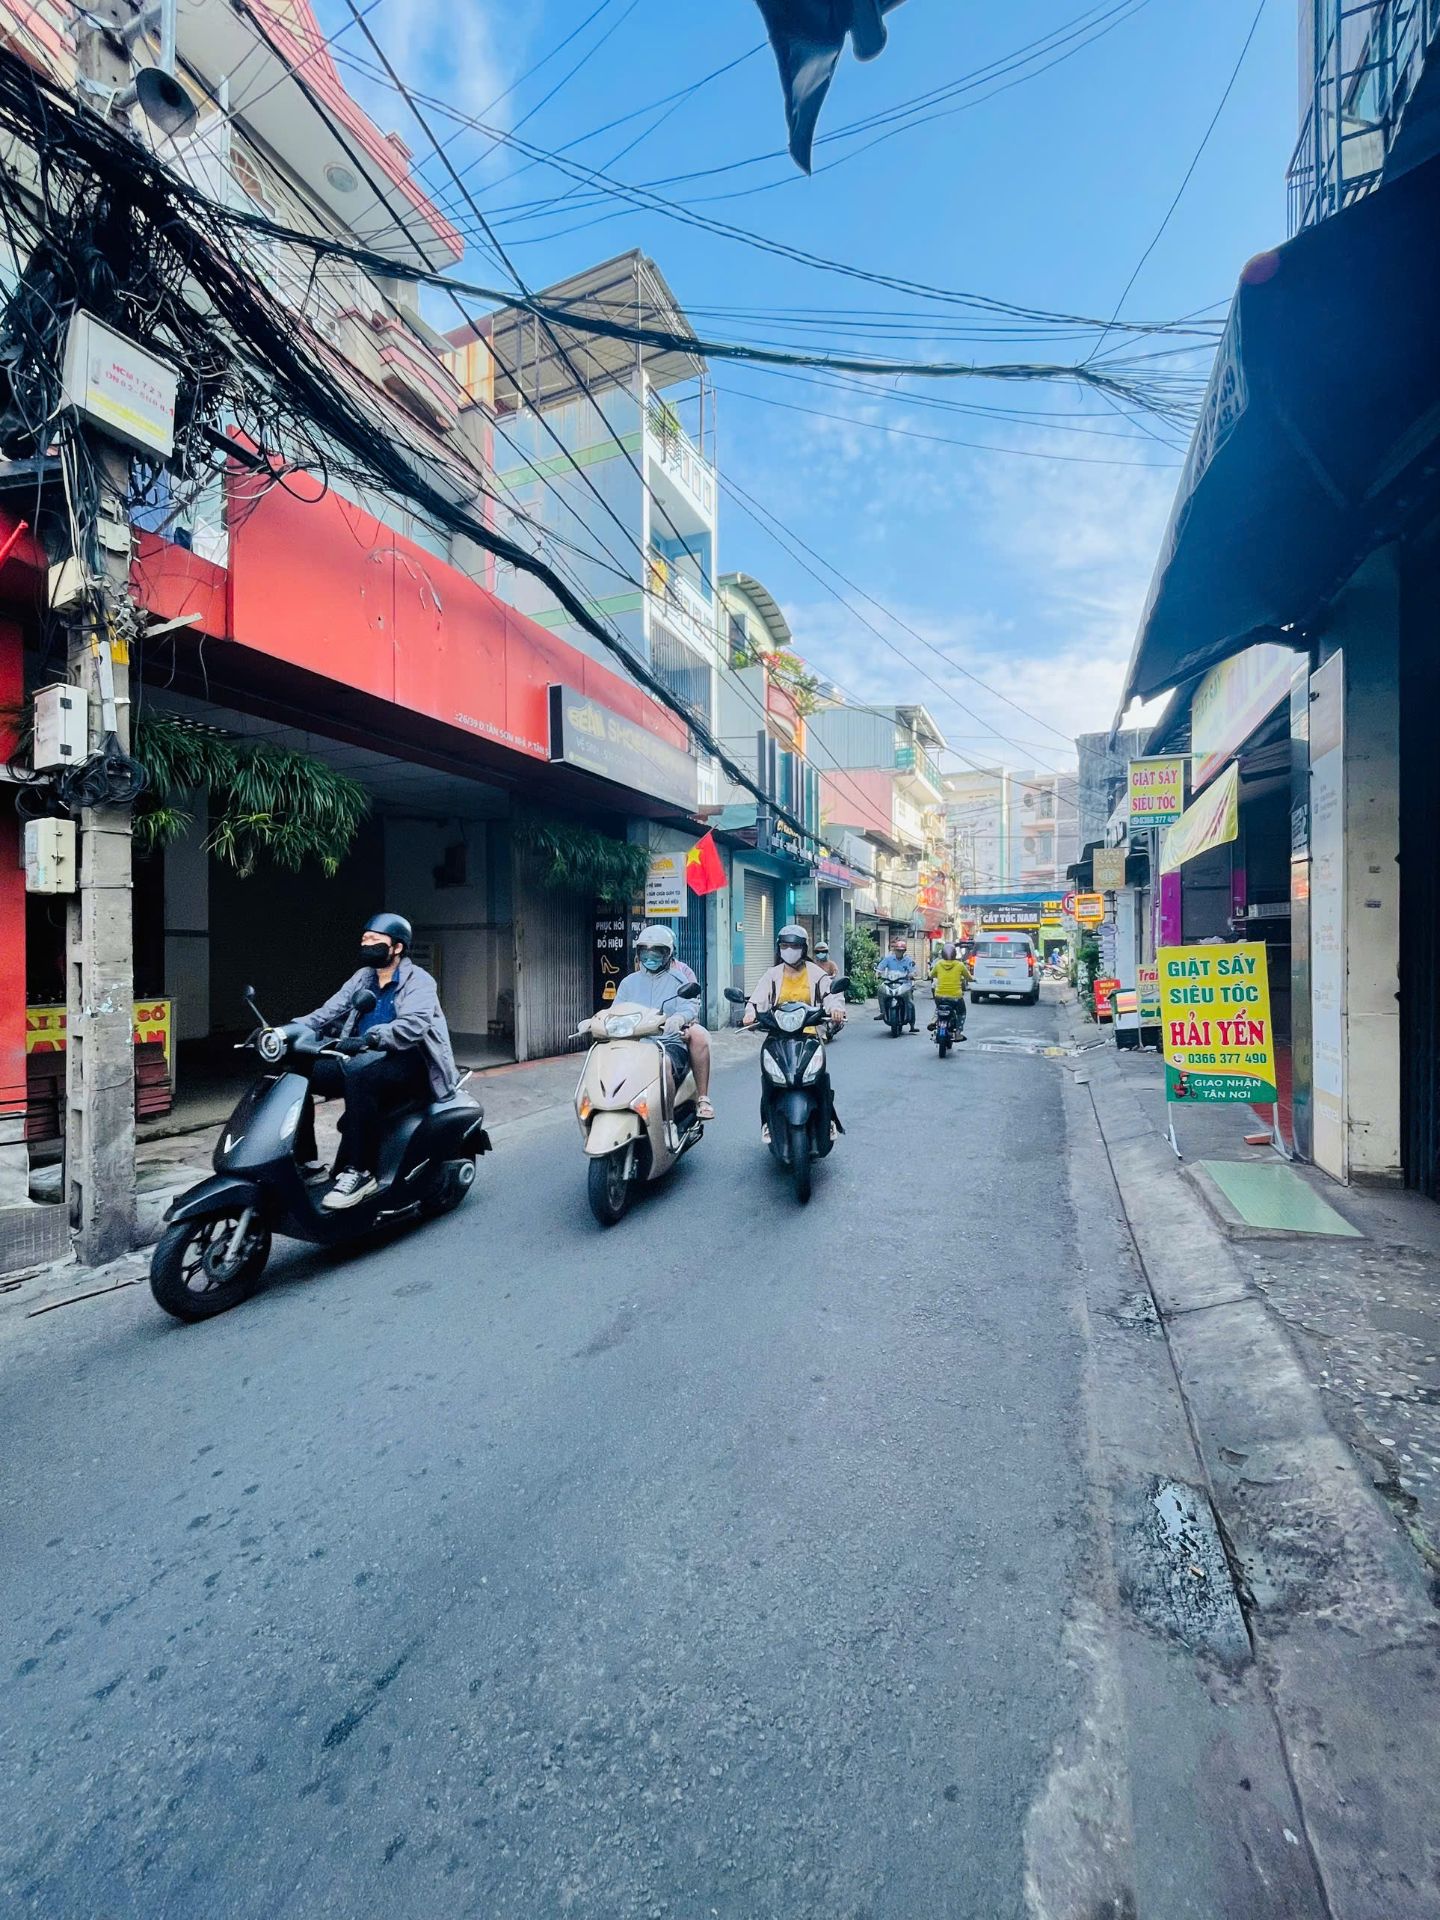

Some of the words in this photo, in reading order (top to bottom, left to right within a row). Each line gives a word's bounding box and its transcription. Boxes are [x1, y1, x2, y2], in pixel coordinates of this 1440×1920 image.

[1132, 768, 1155, 789] GIẶT
[1158, 763, 1178, 784] SẤY
[1132, 793, 1154, 811] SIÊU
[1156, 790, 1176, 810] TỐC
[595, 921, 612, 933] PHỤC
[613, 916, 625, 931] HỒI
[982, 911, 999, 923] CẮT
[1017, 912, 1038, 923] NAM
[608, 935, 624, 951] HIỆU
[1167, 957, 1211, 980] GIẶT
[1217, 953, 1256, 976] SẤY
[1169, 985, 1214, 1004] SIÊU
[1220, 981, 1259, 1003] TỐC
[137, 1003, 165, 1022] SỐ
[1169, 1010, 1212, 1046] HẢI
[1216, 1008, 1265, 1046] YẾN
[1188, 1053, 1216, 1064] 0366
[1220, 1053, 1241, 1064] 377
[1245, 1053, 1267, 1064] 490
[1194, 1079, 1223, 1087] GIAO
[1227, 1078, 1262, 1090] NHẬN
[1203, 1089, 1226, 1101] TẬN
[1229, 1090, 1251, 1099] NƠI
